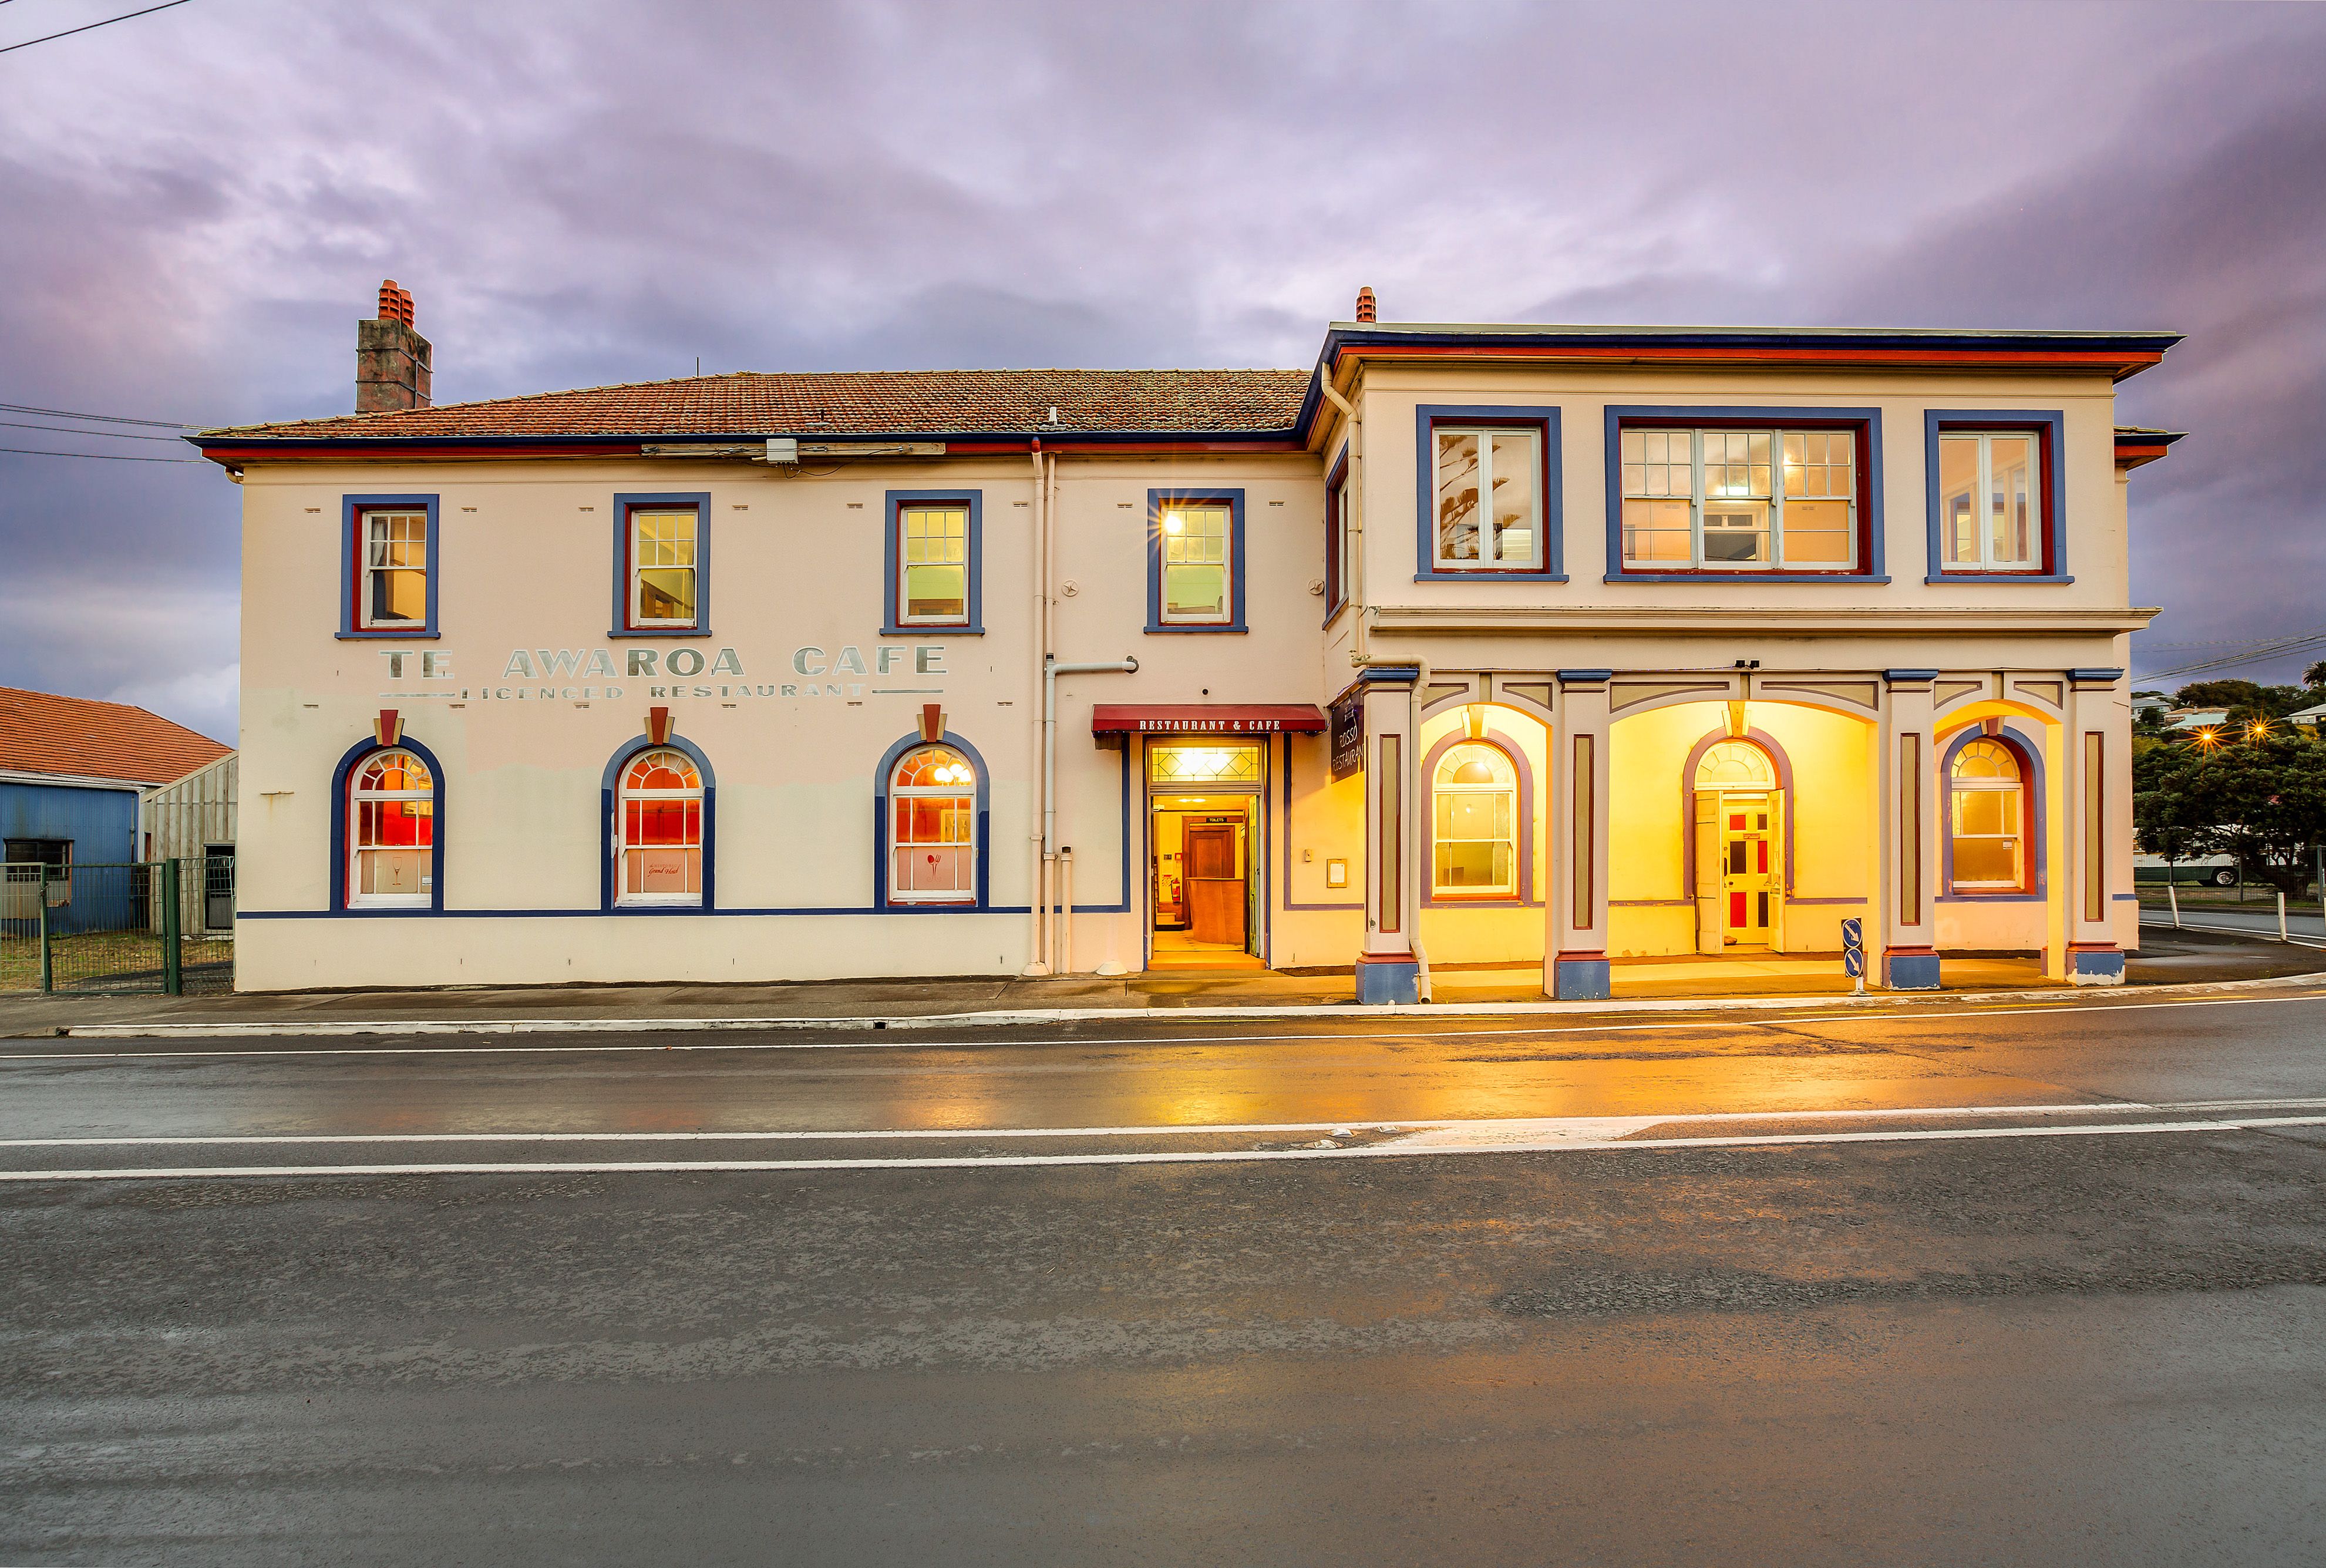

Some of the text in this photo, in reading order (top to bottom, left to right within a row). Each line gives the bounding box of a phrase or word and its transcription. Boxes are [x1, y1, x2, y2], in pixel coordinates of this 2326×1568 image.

[379, 646, 948, 679] TE AWAROA CAFE
[460, 683, 866, 700] LICENCED RESTAURANT
[1139, 720, 1280, 731] RESTAURANT & CAFE
[1339, 725, 1358, 748] ROSSO
[1332, 743, 1365, 772] RESTAURAN
[647, 864, 681, 877] Grand Hotel
